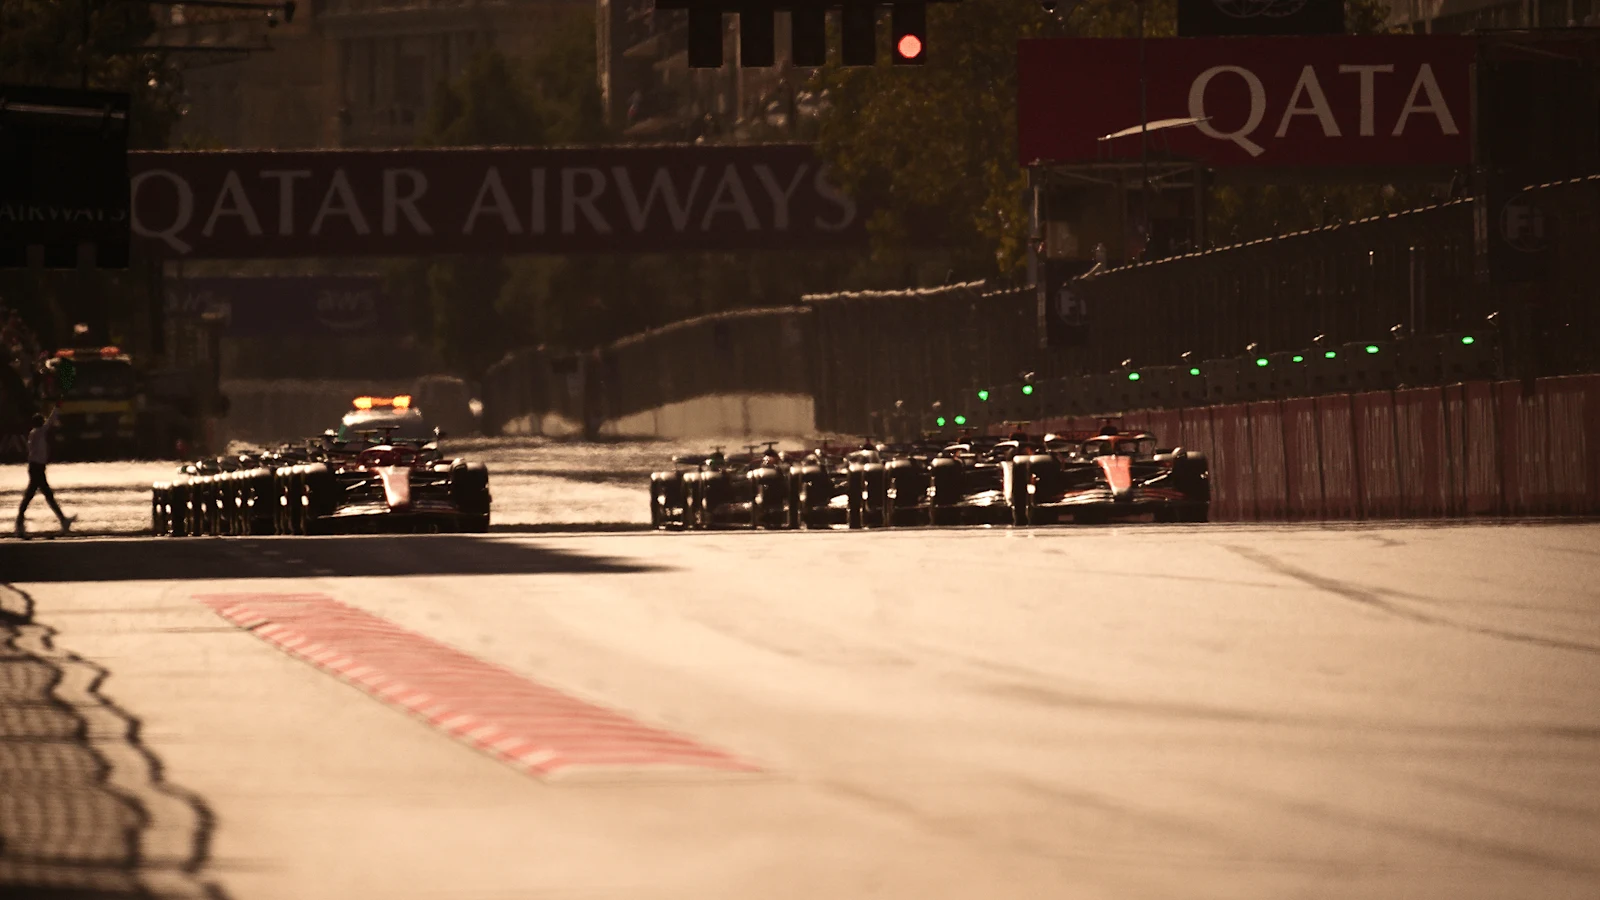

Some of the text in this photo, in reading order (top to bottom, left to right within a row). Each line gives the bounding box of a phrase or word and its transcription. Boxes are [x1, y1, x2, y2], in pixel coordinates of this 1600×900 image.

[1188, 63, 1459, 157] QATA
[130, 163, 858, 253] QATAR AIRWAYS
